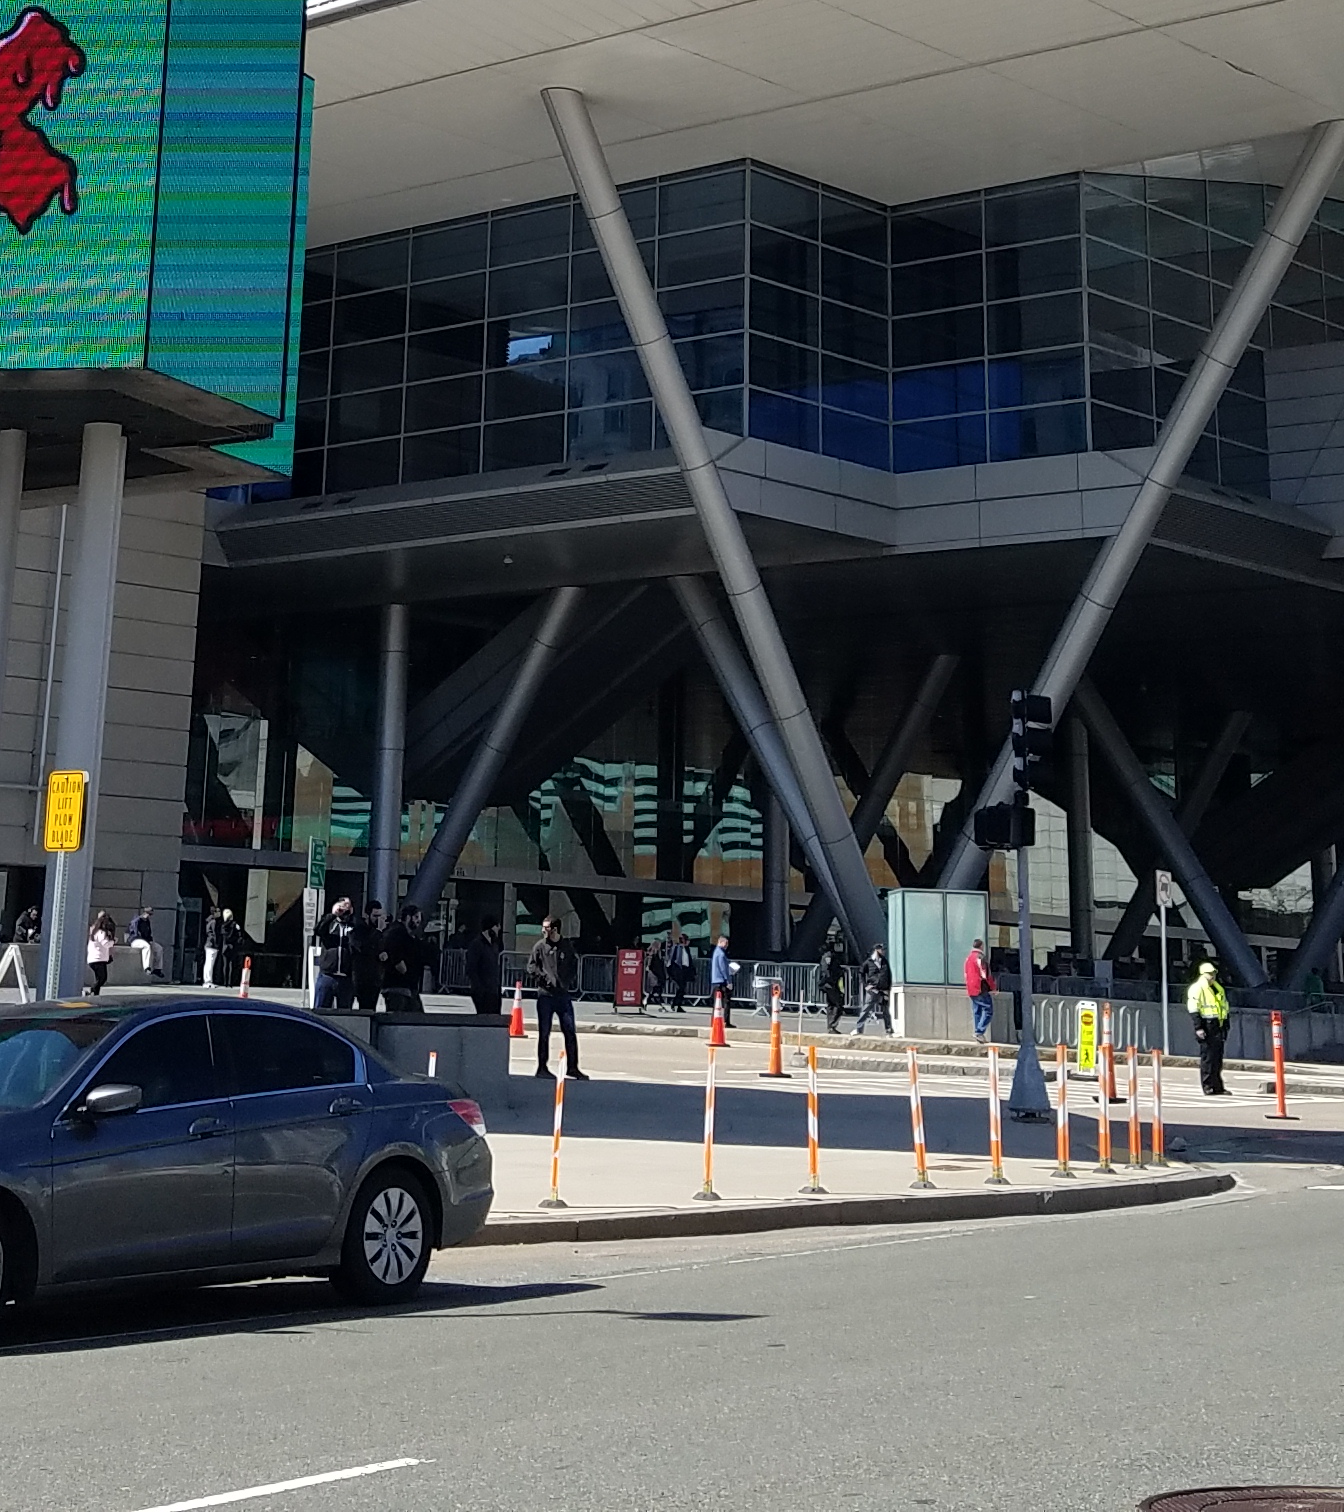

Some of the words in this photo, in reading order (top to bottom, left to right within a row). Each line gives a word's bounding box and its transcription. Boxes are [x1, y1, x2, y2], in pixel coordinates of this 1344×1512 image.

[52, 781, 81, 794] CAUTION
[57, 797, 73, 810] LIFT
[54, 813, 74, 826] PLOW
[51, 829, 74, 843] BLADE
